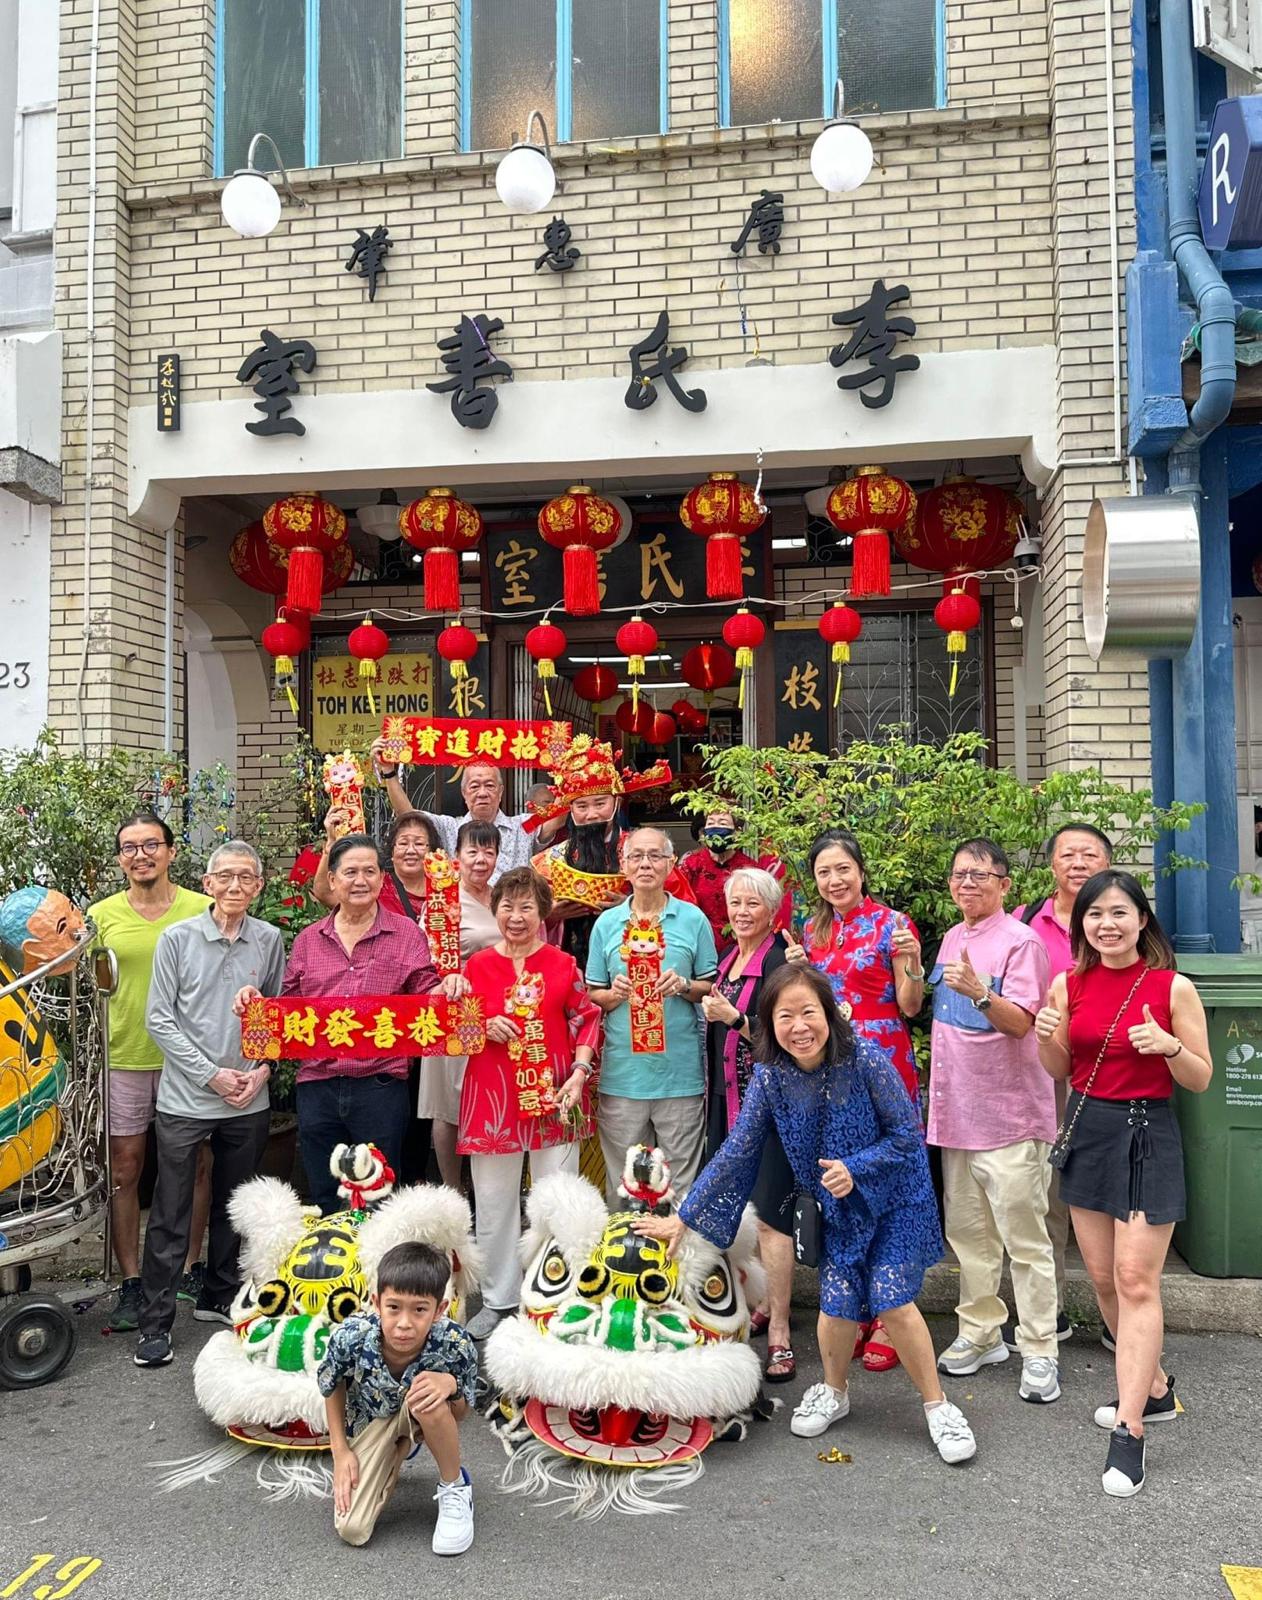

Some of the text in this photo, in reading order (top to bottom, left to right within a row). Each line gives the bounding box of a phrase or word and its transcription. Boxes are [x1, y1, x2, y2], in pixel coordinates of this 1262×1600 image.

[1211, 132, 1237, 227] R
[317, 693, 429, 715] TOH KEE HONG
[515, 1020, 548, 1111] 萬事如意
